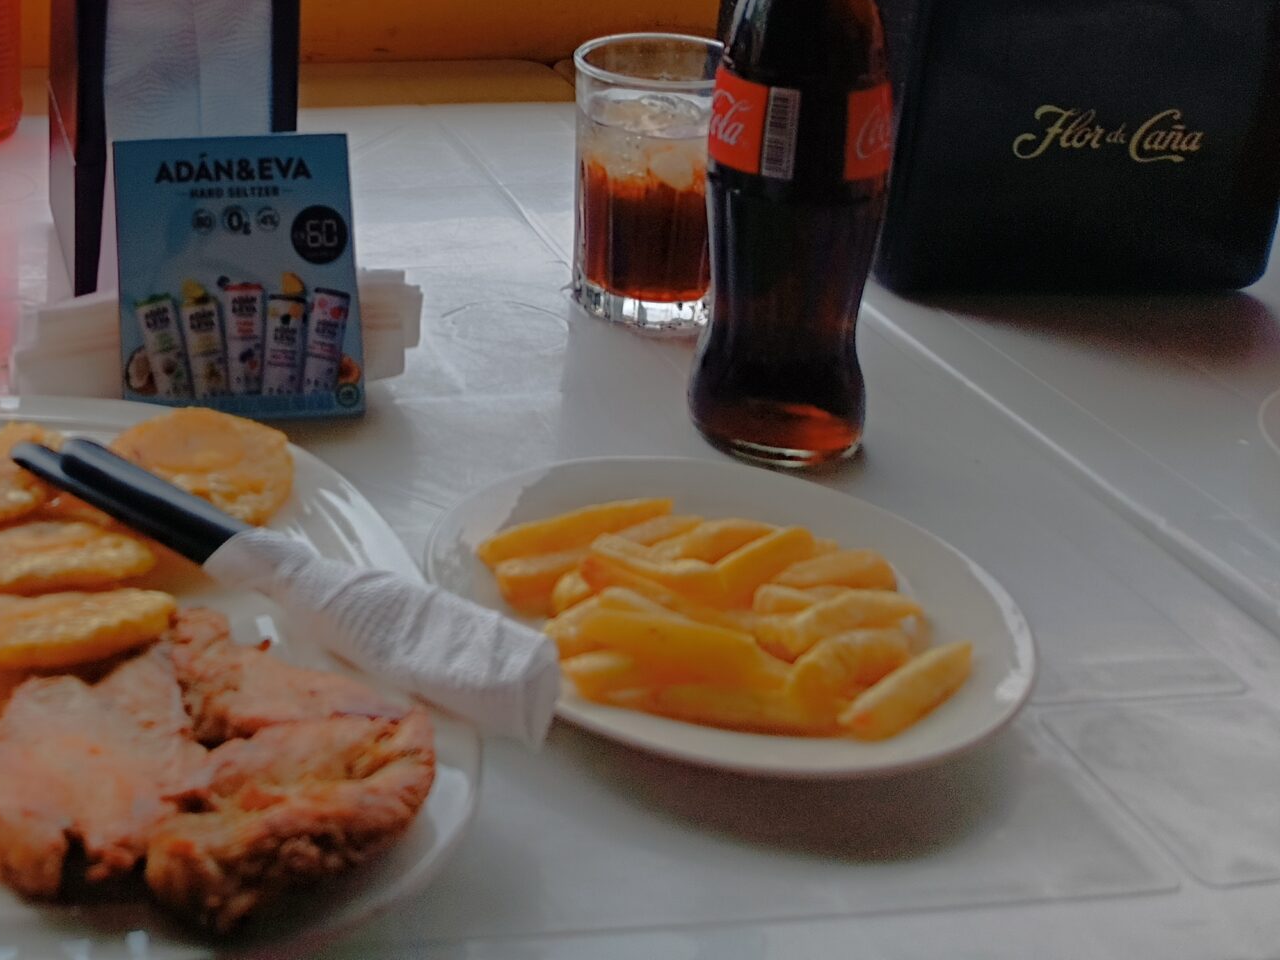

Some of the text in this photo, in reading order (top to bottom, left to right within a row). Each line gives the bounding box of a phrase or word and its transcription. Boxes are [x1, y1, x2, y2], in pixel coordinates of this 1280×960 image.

[1012, 103, 1206, 163] Flor de Caña
[155, 153, 312, 183] ADÁN&EVA
[190, 187, 224, 199] HARD
